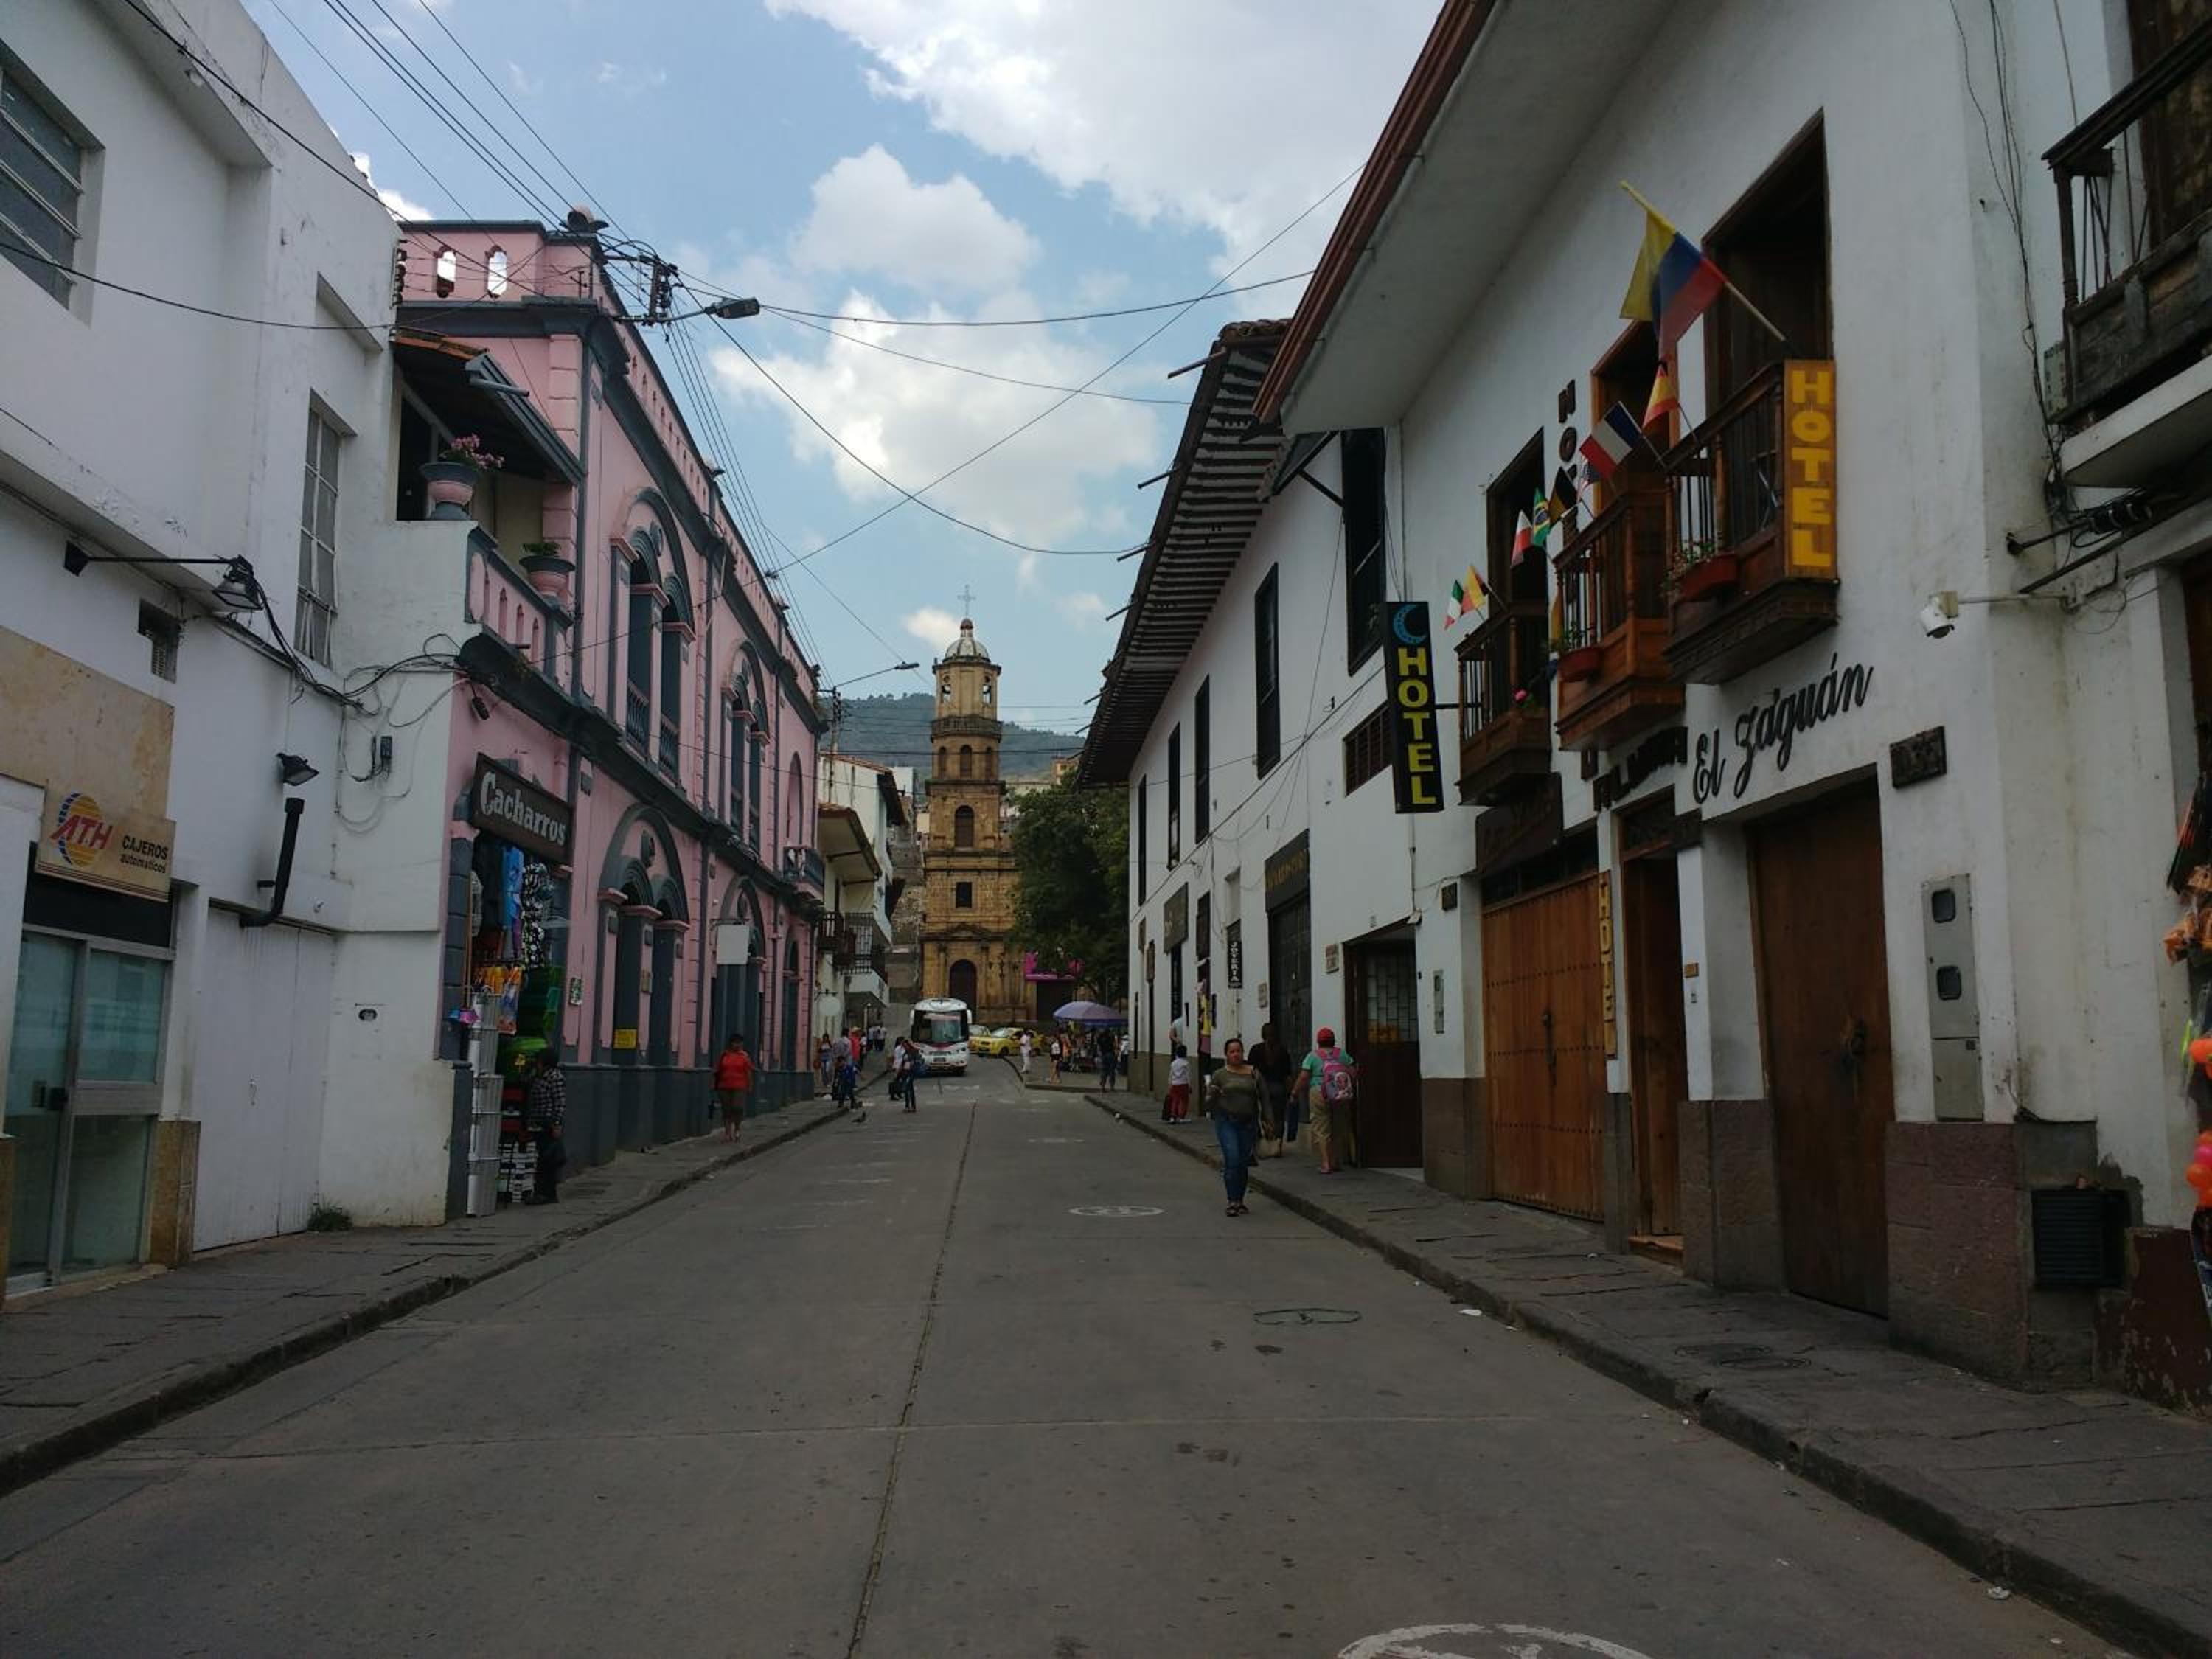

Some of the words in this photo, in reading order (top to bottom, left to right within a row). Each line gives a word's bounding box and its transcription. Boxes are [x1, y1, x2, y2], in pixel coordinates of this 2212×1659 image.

[1791, 370, 1832, 568] HOTEL
[1397, 647, 1437, 805] HOTEL
[1693, 728, 1726, 804] El
[49, 814, 113, 849] ATH
[480, 771, 566, 846] Cacharros
[122, 835, 168, 860] CAJEROS
